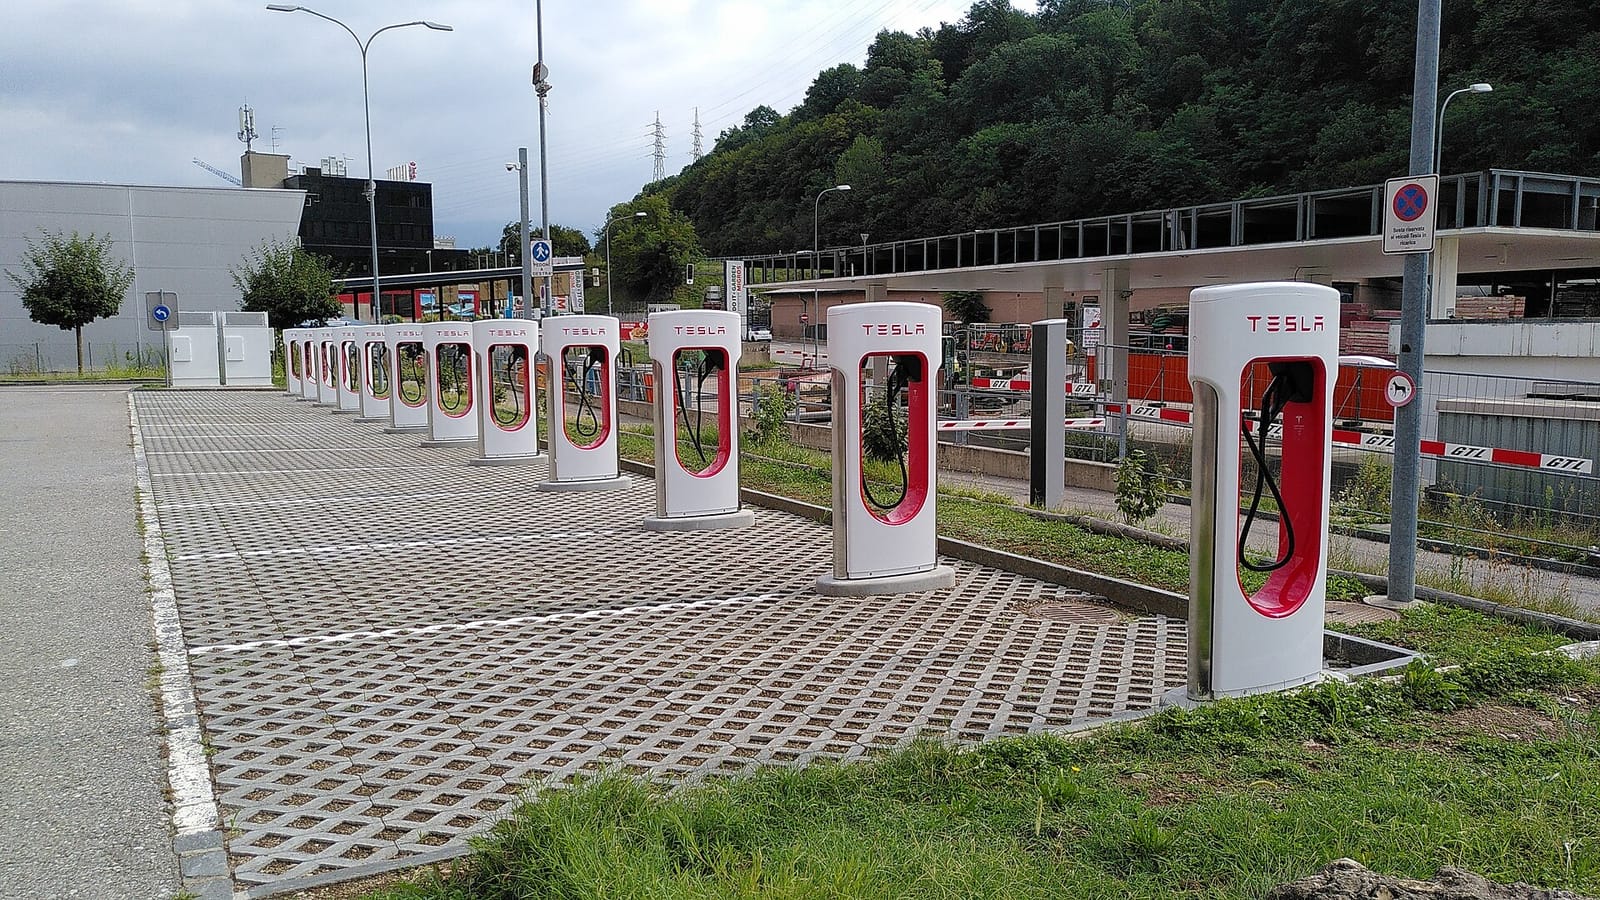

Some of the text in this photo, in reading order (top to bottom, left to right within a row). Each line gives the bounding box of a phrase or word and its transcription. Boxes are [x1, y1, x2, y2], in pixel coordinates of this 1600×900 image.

[1246, 316, 1324, 332] TESLA
[562, 328, 607, 336] TESLA
[674, 326, 726, 335] TESLA
[862, 324, 924, 335] TESLA
[992, 379, 1008, 388] GTL
[1075, 384, 1094, 393] GTL
[1134, 407, 1157, 416] GTL
[1450, 446, 1487, 458] GTL
[1546, 457, 1585, 471] GTL
